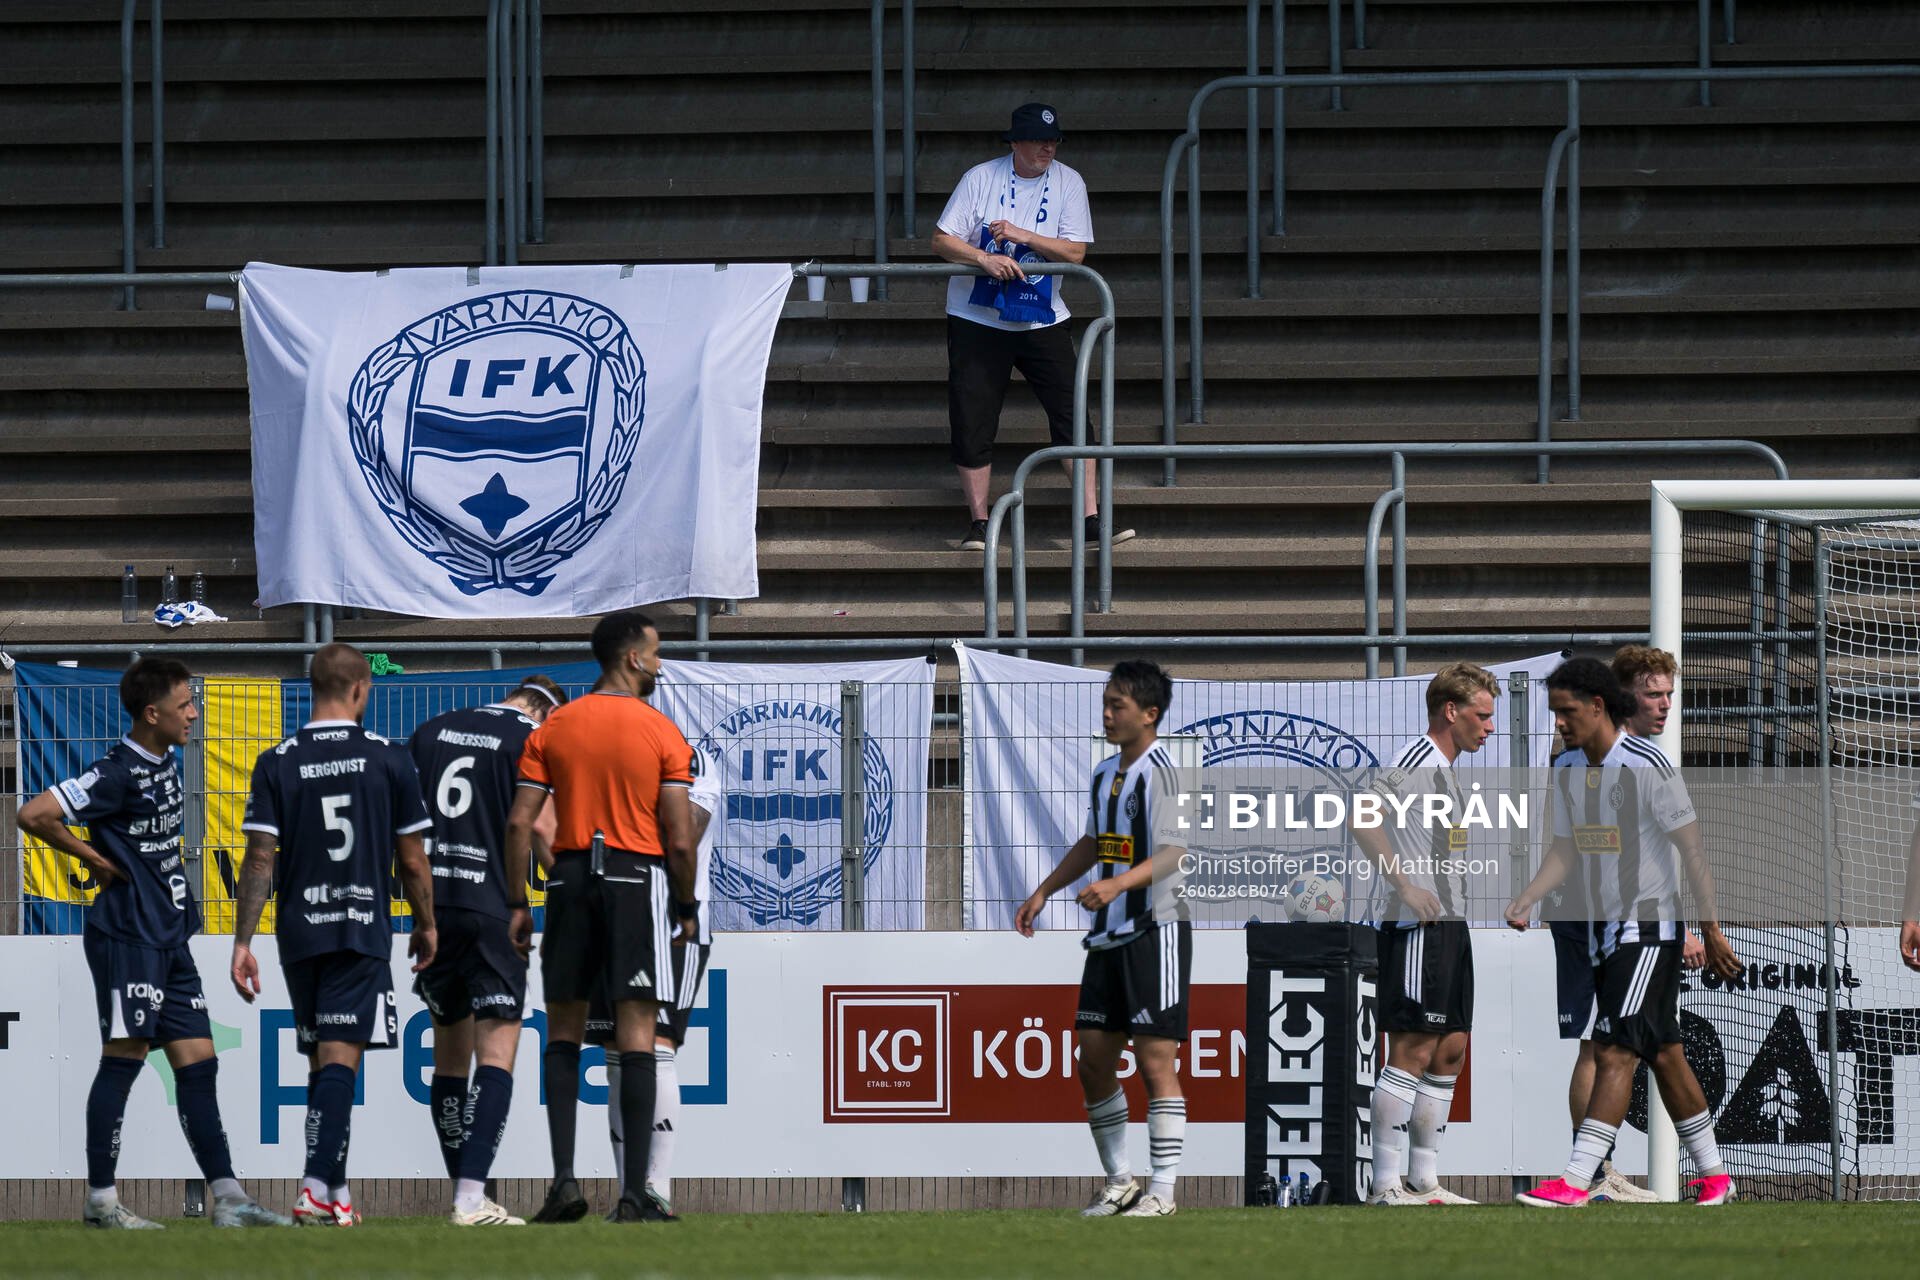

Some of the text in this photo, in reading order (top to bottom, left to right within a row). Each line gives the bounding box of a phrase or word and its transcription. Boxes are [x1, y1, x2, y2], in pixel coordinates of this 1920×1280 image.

[1019, 292, 1038, 301] 2014
[407, 295, 613, 347] VÄRNAMO
[448, 353, 581, 398] IFK
[437, 728, 502, 751] ANDERSSON
[299, 758, 367, 780] BERGQVIST
[742, 750, 829, 781] IFK
[437, 757, 476, 819] 6
[321, 794, 354, 862] 5
[1300, 880, 1321, 911] SELECT
[135, 1008, 146, 1026] 9
[387, 1015, 397, 1034] 5
[858, 1029, 922, 1072] KC
[1266, 969, 1326, 1200] SELECT
